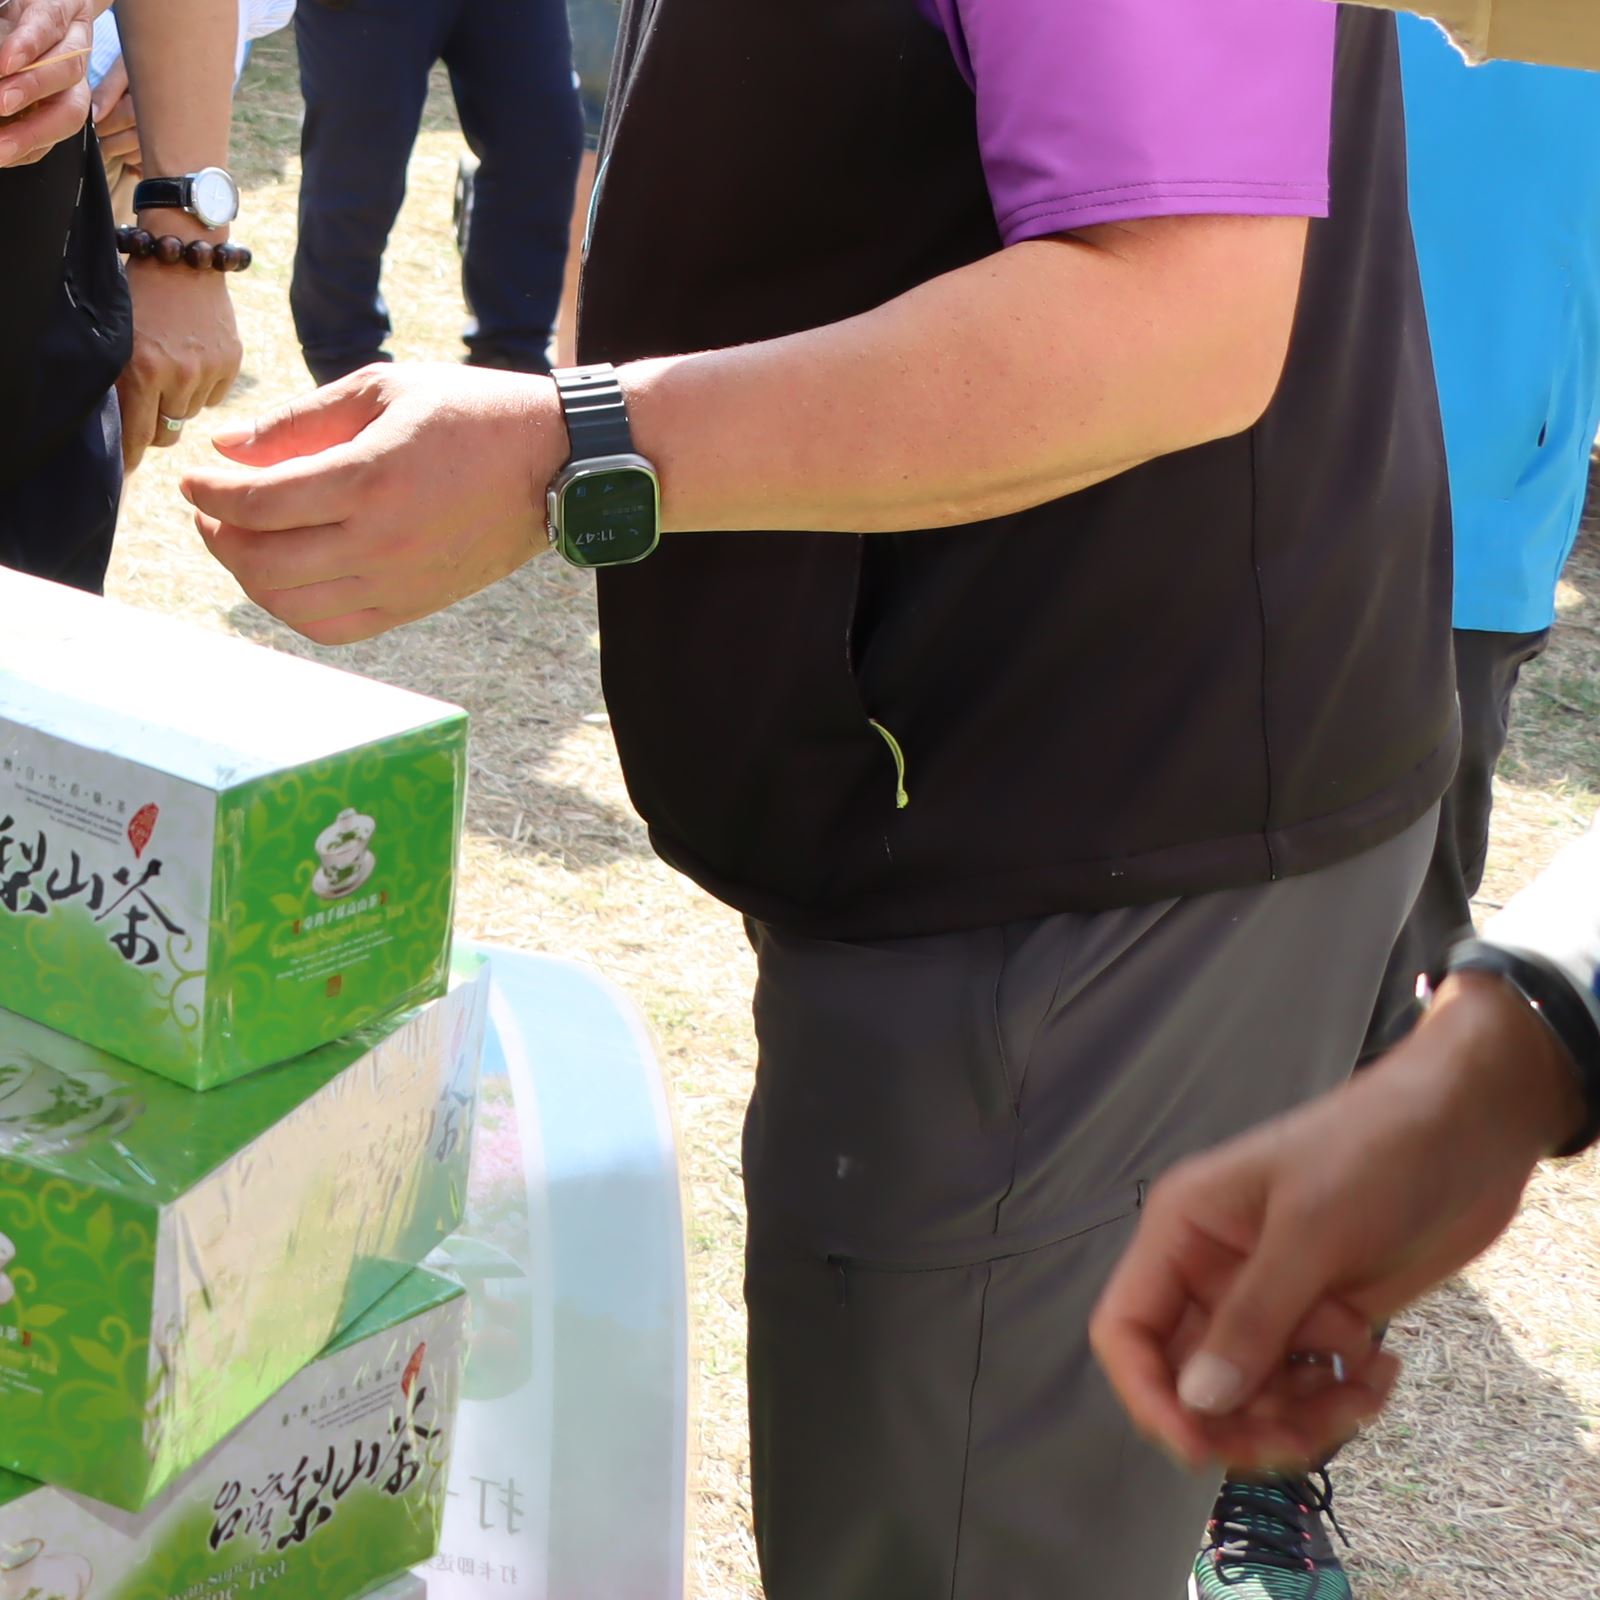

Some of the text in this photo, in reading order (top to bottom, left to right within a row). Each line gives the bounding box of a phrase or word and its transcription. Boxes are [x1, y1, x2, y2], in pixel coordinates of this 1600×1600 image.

[575, 527, 616, 547] 11:47
[208, 1386, 442, 1553] 台灣梨山茶
